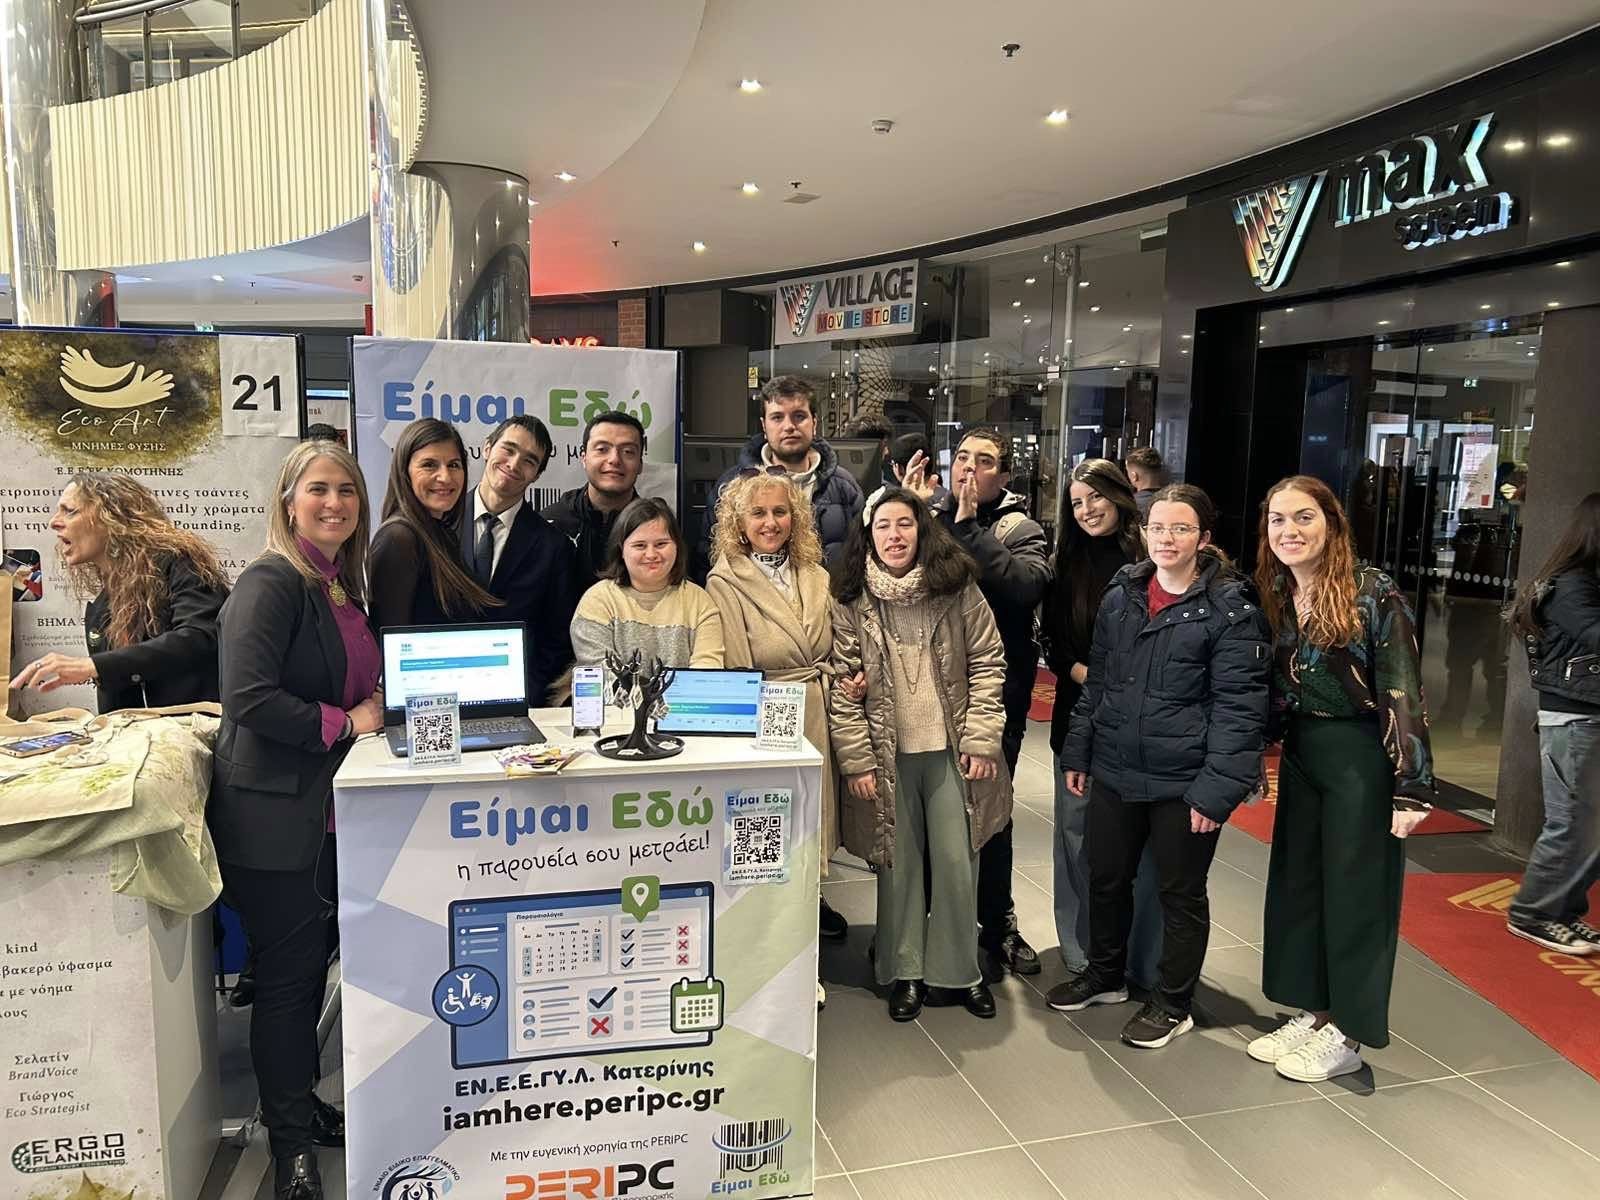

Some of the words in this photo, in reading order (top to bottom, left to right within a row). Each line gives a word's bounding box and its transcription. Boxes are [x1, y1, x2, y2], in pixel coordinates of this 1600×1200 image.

[1395, 191, 1517, 250] screen
[825, 266, 915, 309] VILLAGE
[231, 373, 283, 413] 21
[57, 407, 107, 436] Eco
[110, 404, 175, 437] Art
[72, 440, 125, 451] ΜΝΗΜΕΣ
[127, 441, 168, 452] ΦΥΣΗΣ
[153, 489, 189, 500] τινες
[195, 487, 249, 500] τσάντες
[203, 503, 265, 517] χρώματα
[4, 523, 20, 531] αι
[174, 519, 246, 533] Pounding.
[37, 617, 77, 628] ΒΗΜΑ
[727, 795, 760, 808] Είμαι
[764, 793, 790, 804] Εδώ
[448, 797, 590, 847] Είμαι
[611, 785, 714, 830] Εδώ
[457, 861, 471, 881] η
[478, 846, 578, 880] παρουσία
[628, 830, 711, 868] μετράει!
[6, 941, 39, 954] kind
[1, 962, 53, 979] βακερό
[58, 959, 113, 973] ύφασμα
[9, 988, 25, 999] με
[30, 983, 74, 997] νόημα
[0, 1009, 28, 1019] ους
[14, 1051, 70, 1065] Σελατίν
[8, 1066, 79, 1080] BrandVoice
[454, 1067, 595, 1097] ΕΝ.Ε.Ε.ΓΥ.Λ.
[603, 1058, 715, 1087] Κατερίνης
[19, 1089, 75, 1104] Γιώργος
[5, 1107, 27, 1119] Eco
[30, 1102, 91, 1116] Strategist
[442, 1086, 726, 1132] iamhere.peripc.gr
[32, 1132, 124, 1155] ERGO
[490, 1151, 507, 1162] Με
[509, 1149, 530, 1162] την
[532, 1143, 581, 1159] ευγενική
[583, 1140, 628, 1156] χορηγία
[630, 1139, 649, 1151] της
[650, 1133, 689, 1146] PERIPC
[33, 1148, 126, 1166] PLANNING
[505, 1159, 675, 1200] PERIPC
[711, 1178, 752, 1194] Είμαι
[758, 1170, 791, 1186] Εδώ
